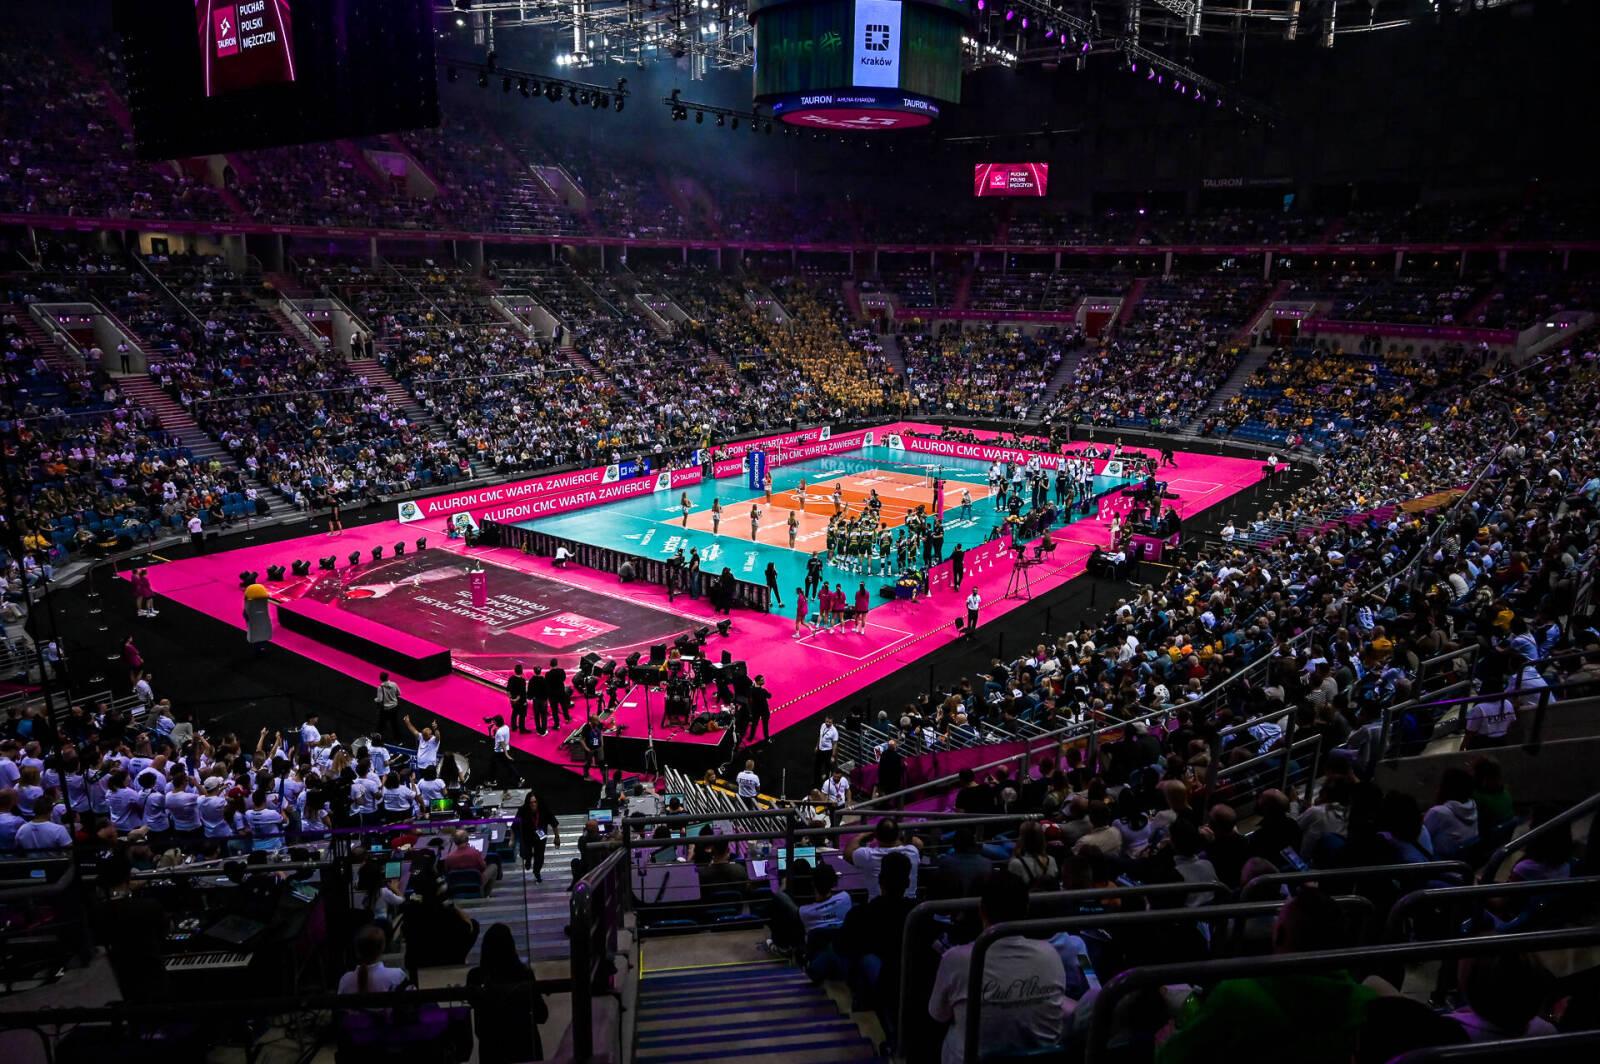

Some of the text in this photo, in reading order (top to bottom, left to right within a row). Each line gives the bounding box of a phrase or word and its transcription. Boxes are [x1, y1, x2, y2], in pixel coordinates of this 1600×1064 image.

[240, 1, 265, 16] PUCHAR
[241, 17, 264, 32] POLSKI
[217, 37, 237, 49] TAURON
[242, 31, 276, 48] MĘŻCZYZN
[860, 56, 892, 67] Kraków
[800, 96, 833, 105] TAURON
[903, 98, 928, 110] TAURON
[789, 449, 803, 459] CMC
[804, 444, 828, 455] WARTA
[828, 437, 861, 451] ZAWIERCIE
[910, 439, 955, 454] ALURON
[956, 444, 980, 457] CMC
[983, 448, 1025, 463] WARTA
[723, 463, 742, 472] TAURON
[680, 472, 701, 481] TAURON
[428, 472, 600, 513] ALURON CMC WARTA ZAWIERCIE
[483, 479, 651, 521] ALURON CMC WARTA ZAWIERCIE
[413, 595, 504, 626] PUCHAR POLSKI
[551, 615, 603, 634] TAURON
